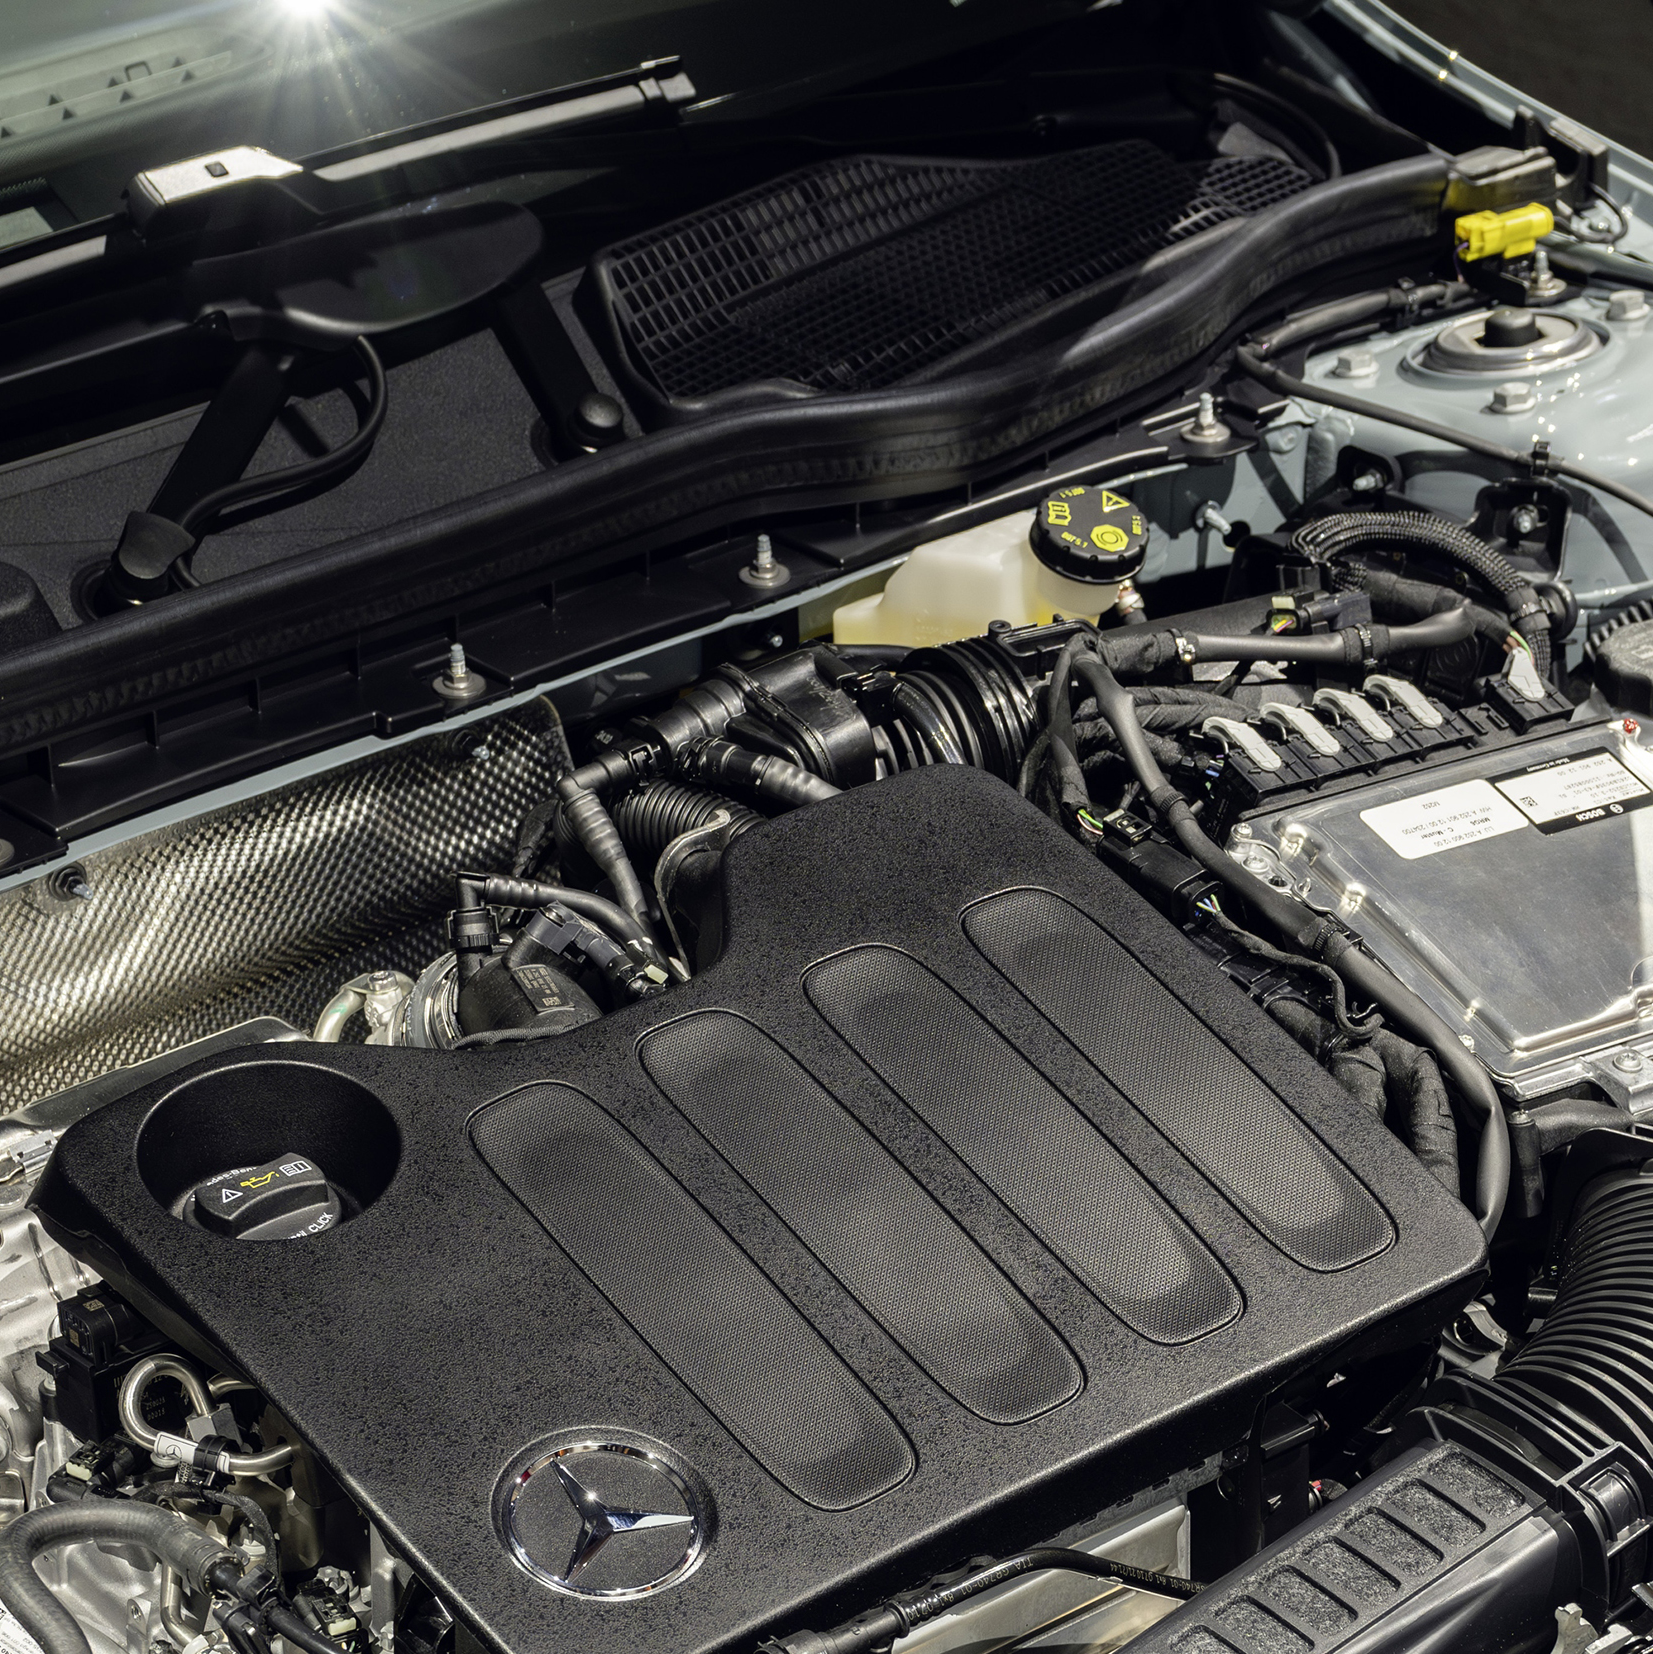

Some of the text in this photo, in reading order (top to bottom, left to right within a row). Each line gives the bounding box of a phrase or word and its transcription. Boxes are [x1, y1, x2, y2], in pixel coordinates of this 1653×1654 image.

[1575, 808, 1607, 823] BOSCH
[1420, 830, 1444, 840] Muster
[308, 1211, 333, 1233] CLICK
[960, 1567, 1011, 1596] GR740-01
